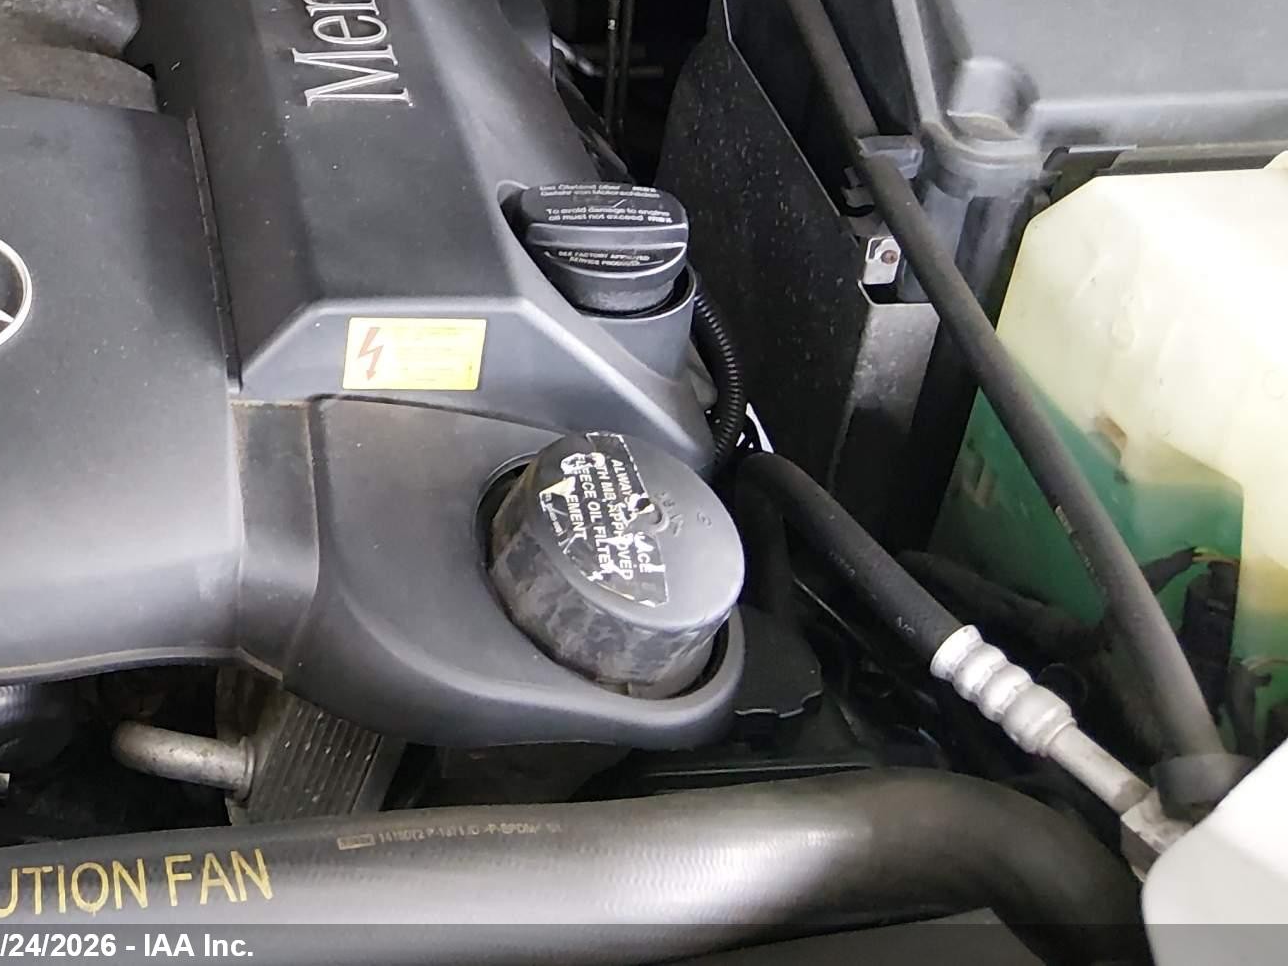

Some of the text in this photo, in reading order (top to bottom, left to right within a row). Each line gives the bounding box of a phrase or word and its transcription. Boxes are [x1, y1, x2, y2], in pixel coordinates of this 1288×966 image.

[588, 207, 625, 215] damage
[588, 501, 602, 522] OIL
[165, 848, 274, 906] FAN
